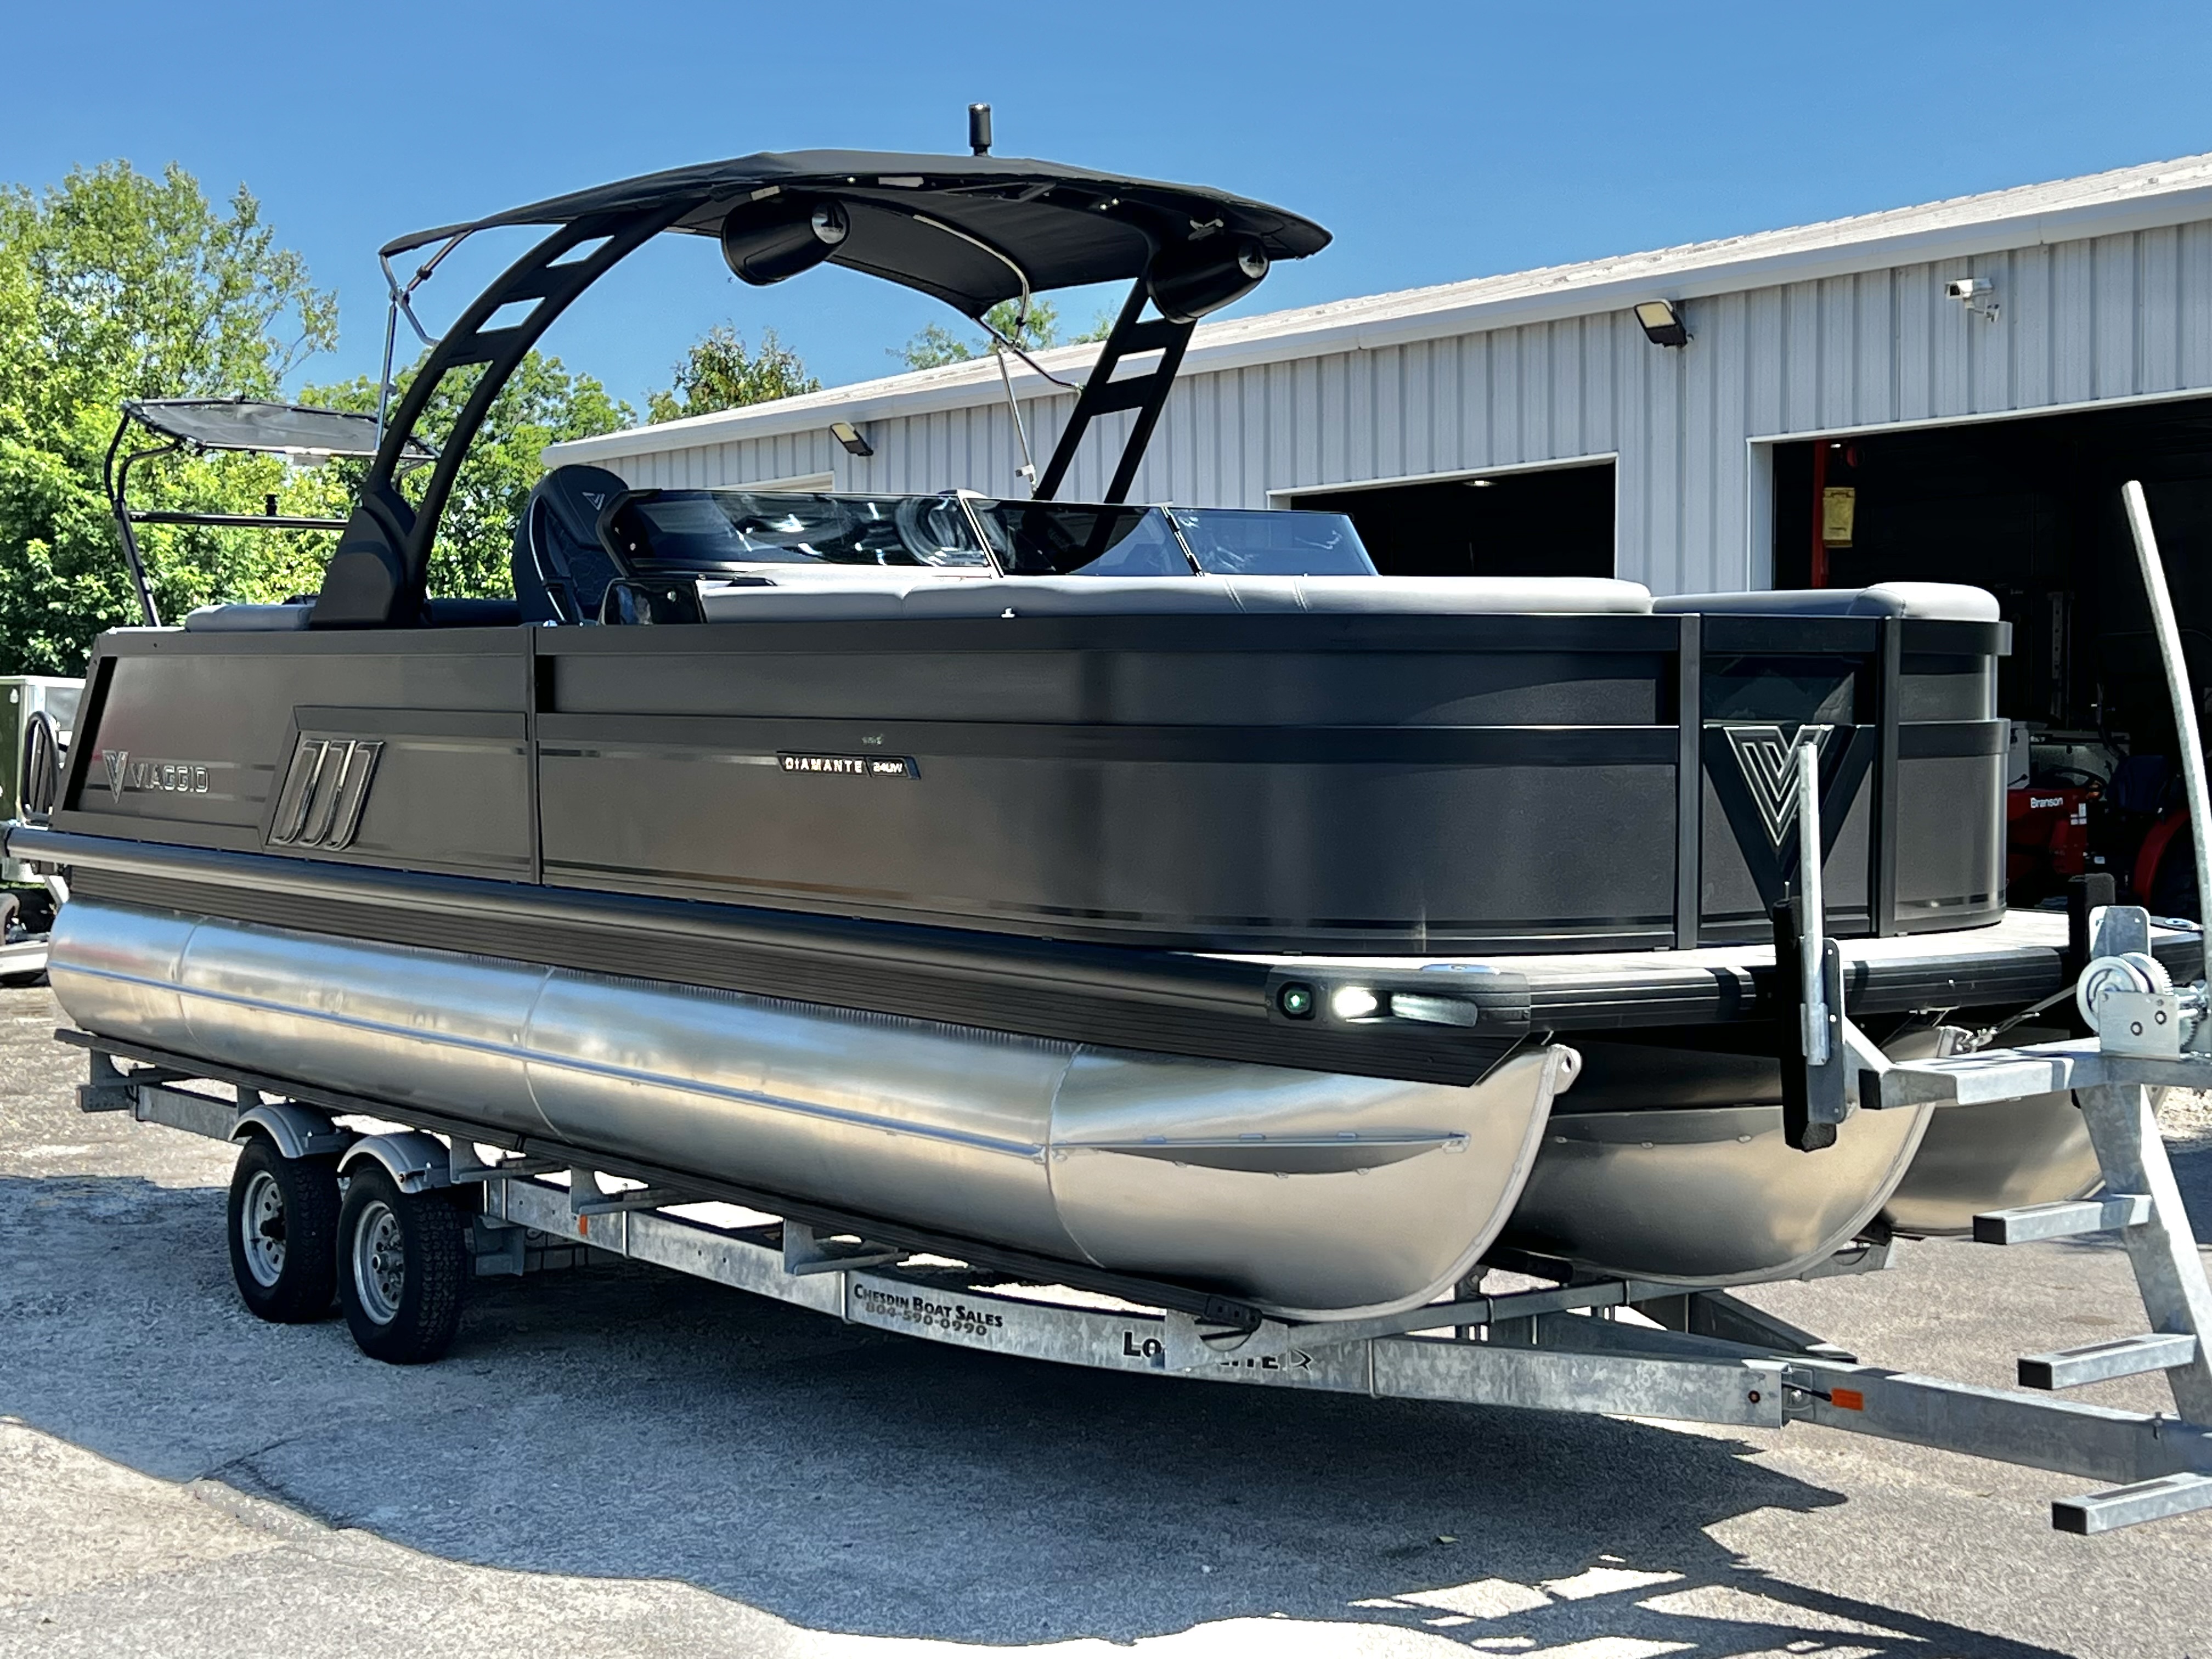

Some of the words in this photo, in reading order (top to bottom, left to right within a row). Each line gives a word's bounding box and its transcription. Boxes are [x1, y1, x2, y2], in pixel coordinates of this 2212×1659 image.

[785, 757, 862, 773] DIAMANTE
[130, 763, 210, 793] VIAGGIO
[2030, 797, 2063, 809] Branson
